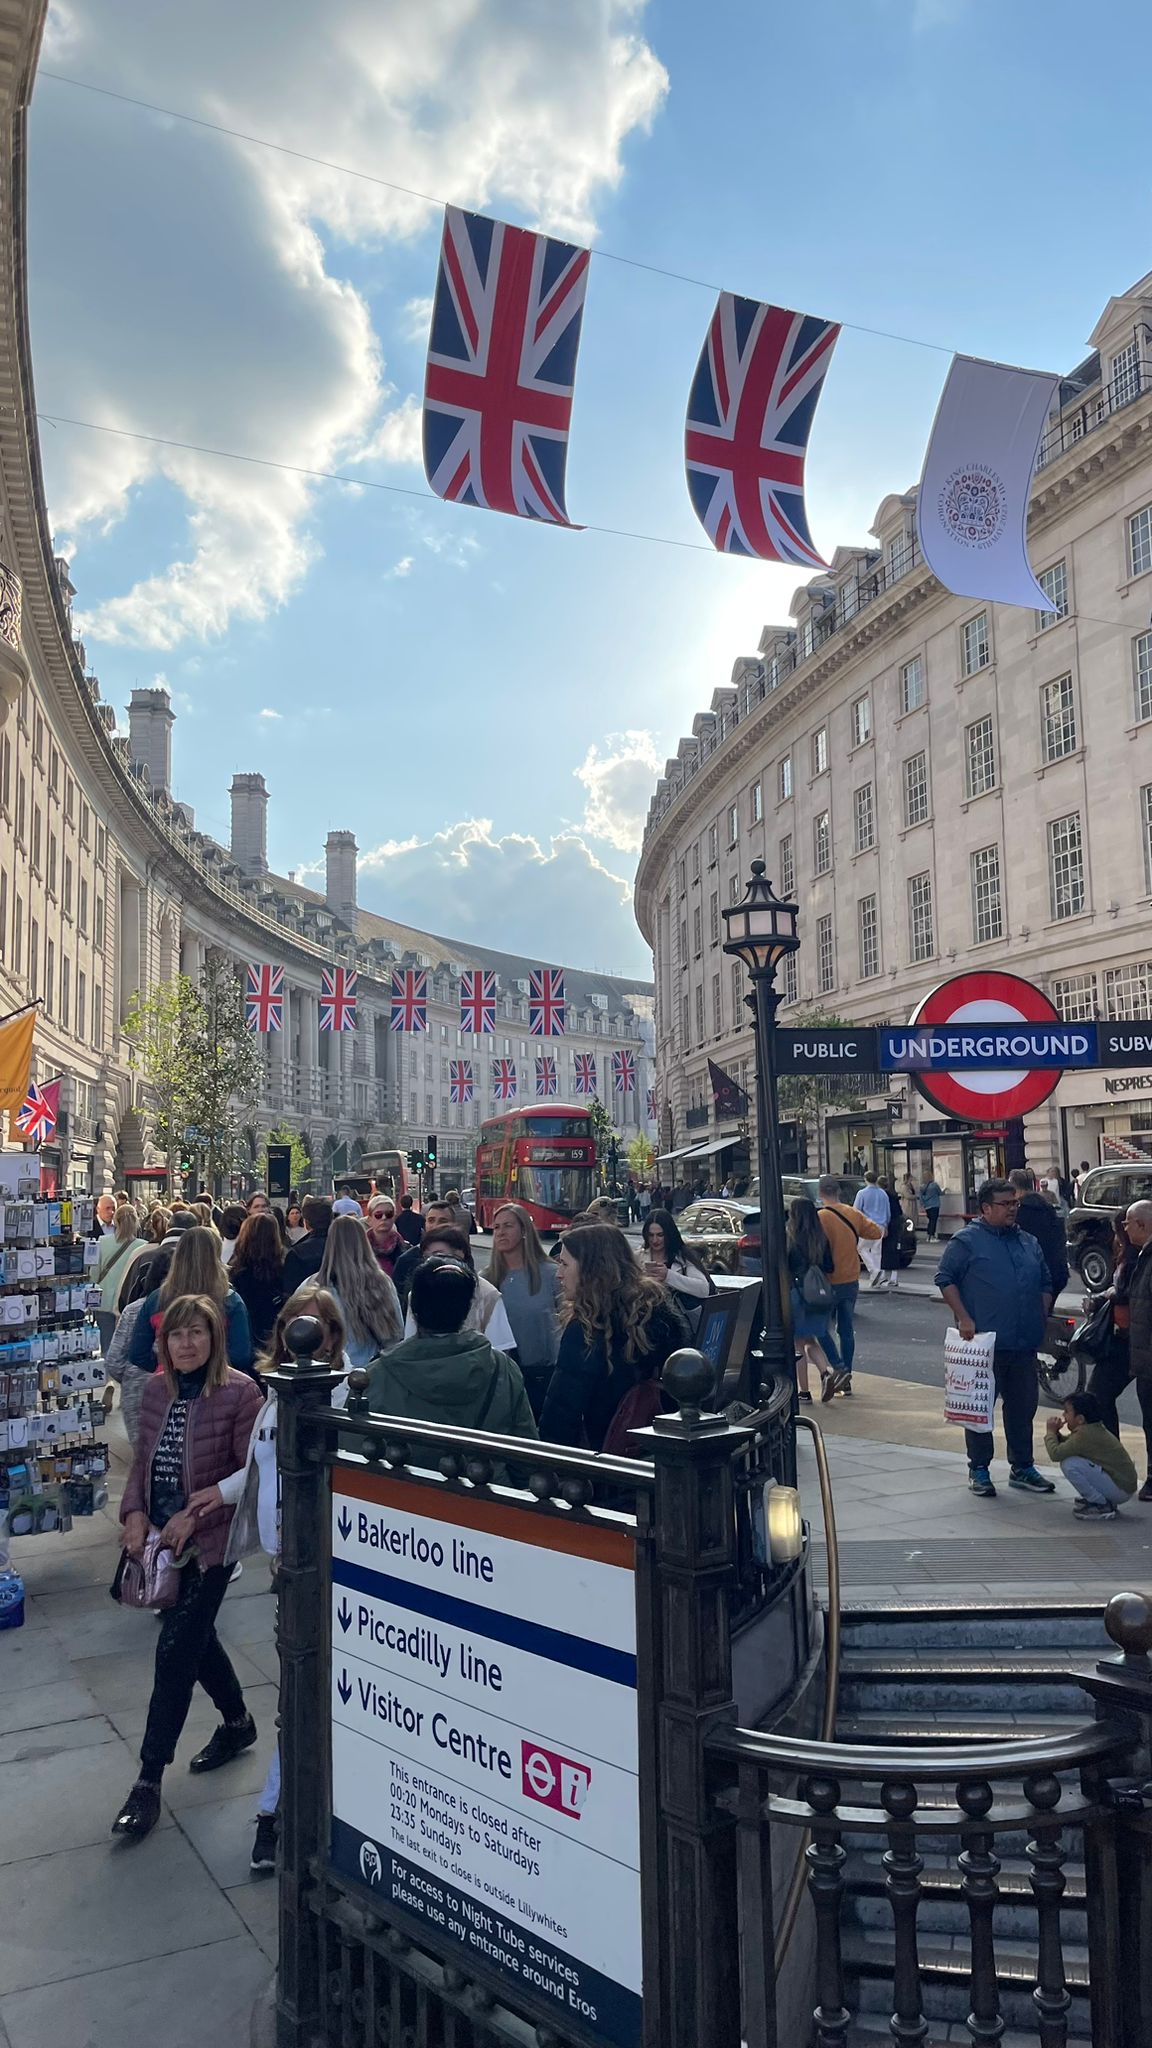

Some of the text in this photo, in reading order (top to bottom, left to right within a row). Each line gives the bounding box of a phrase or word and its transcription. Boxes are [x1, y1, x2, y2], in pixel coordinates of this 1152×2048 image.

[966, 463, 1000, 483] CHARLES
[792, 1042, 858, 1059] PUBLIC
[888, 1035, 1089, 1059] UNDERGROUND
[571, 1149, 584, 1159] 159
[357, 1512, 494, 1583] Bakerloo line
[358, 1605, 503, 1692] Piccadilly line
[358, 1676, 424, 1737] Visitor
[432, 1712, 512, 1779] Centre
[390, 1760, 542, 1853] This entrance is closed after
[390, 1782, 540, 1876] 00:20 Mondays to Saturdays
[390, 1803, 462, 1856] 23:35 Sundays
[390, 1826, 568, 1939] The last exit to close is outside Lillywhites
[391, 1858, 580, 1987] For access to Night Tube services
[391, 1882, 598, 2021] please use any entrance around Eros
